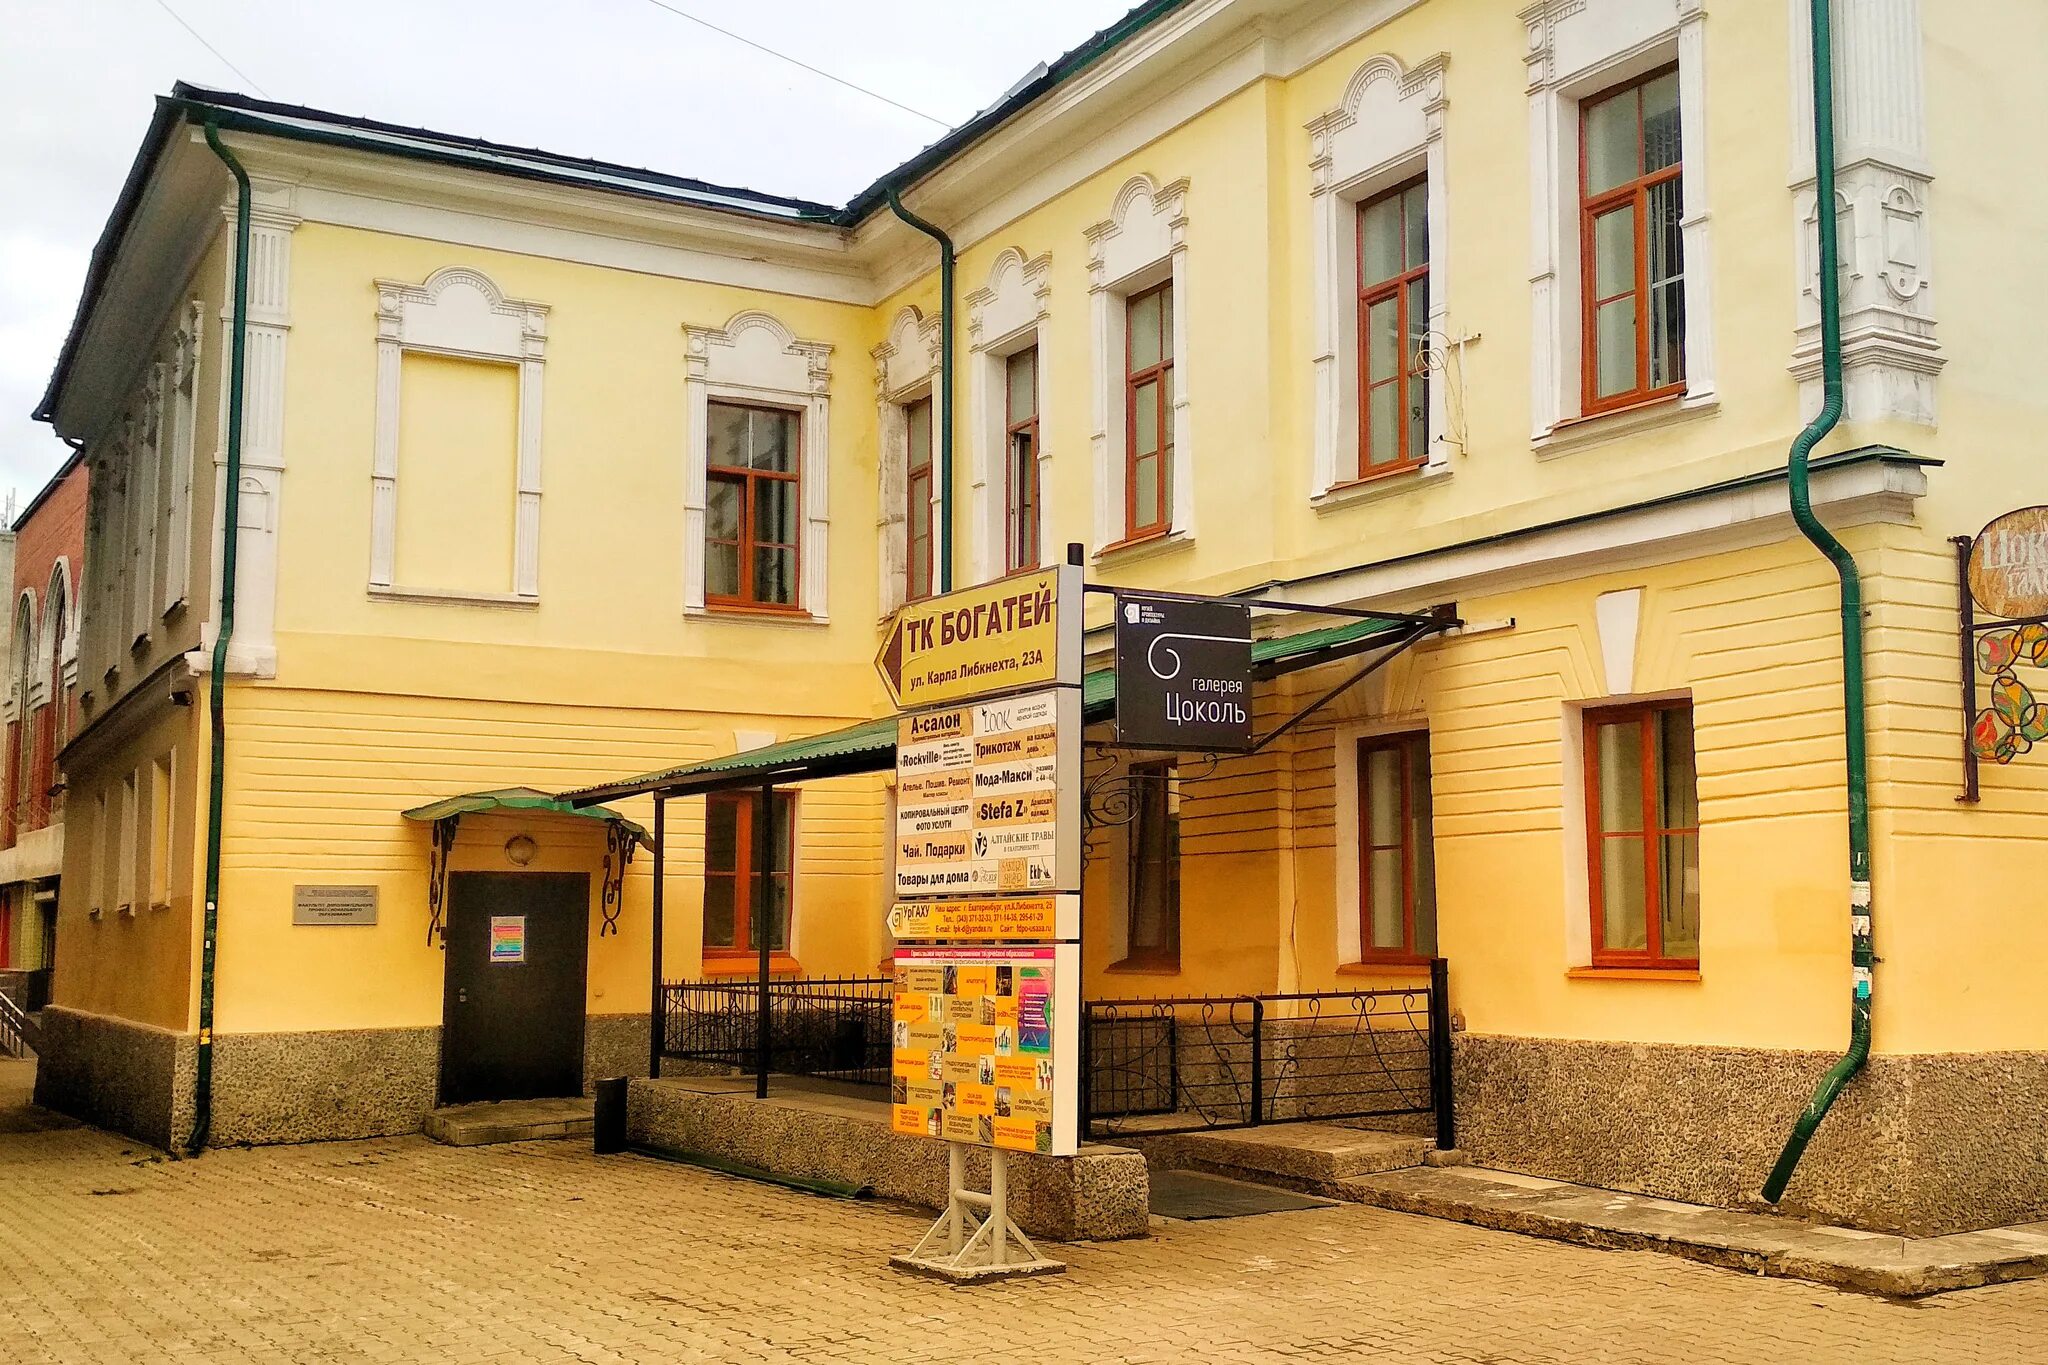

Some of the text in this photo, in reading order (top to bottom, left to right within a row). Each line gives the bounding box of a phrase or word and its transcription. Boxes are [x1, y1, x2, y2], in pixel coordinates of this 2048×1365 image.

[907, 581, 1051, 653] ТК БОГАТЕЙ
[910, 649, 1043, 692] ул. Карла Либкнехта, 23А
[1192, 678, 1243, 698] галерея
[1166, 692, 1246, 726] Цоколь
[911, 713, 960, 735] А-салон
[975, 740, 1021, 758] Трикотаж
[948, 777, 970, 787] Ремонт
[975, 770, 1032, 787] Мода-Макси
[900, 804, 969, 820] КОПИРОВАЛЬНЫЙ ЦЕНТР
[916, 819, 952, 831] ФОТО УСЛУГИ
[991, 830, 1054, 844] АЛТАЙСКИЕ ТРАВЫ
[903, 842, 965, 859] Чай. Подарки
[898, 873, 928, 887] Товары
[930, 873, 944, 886] для
[946, 872, 969, 885] дома
